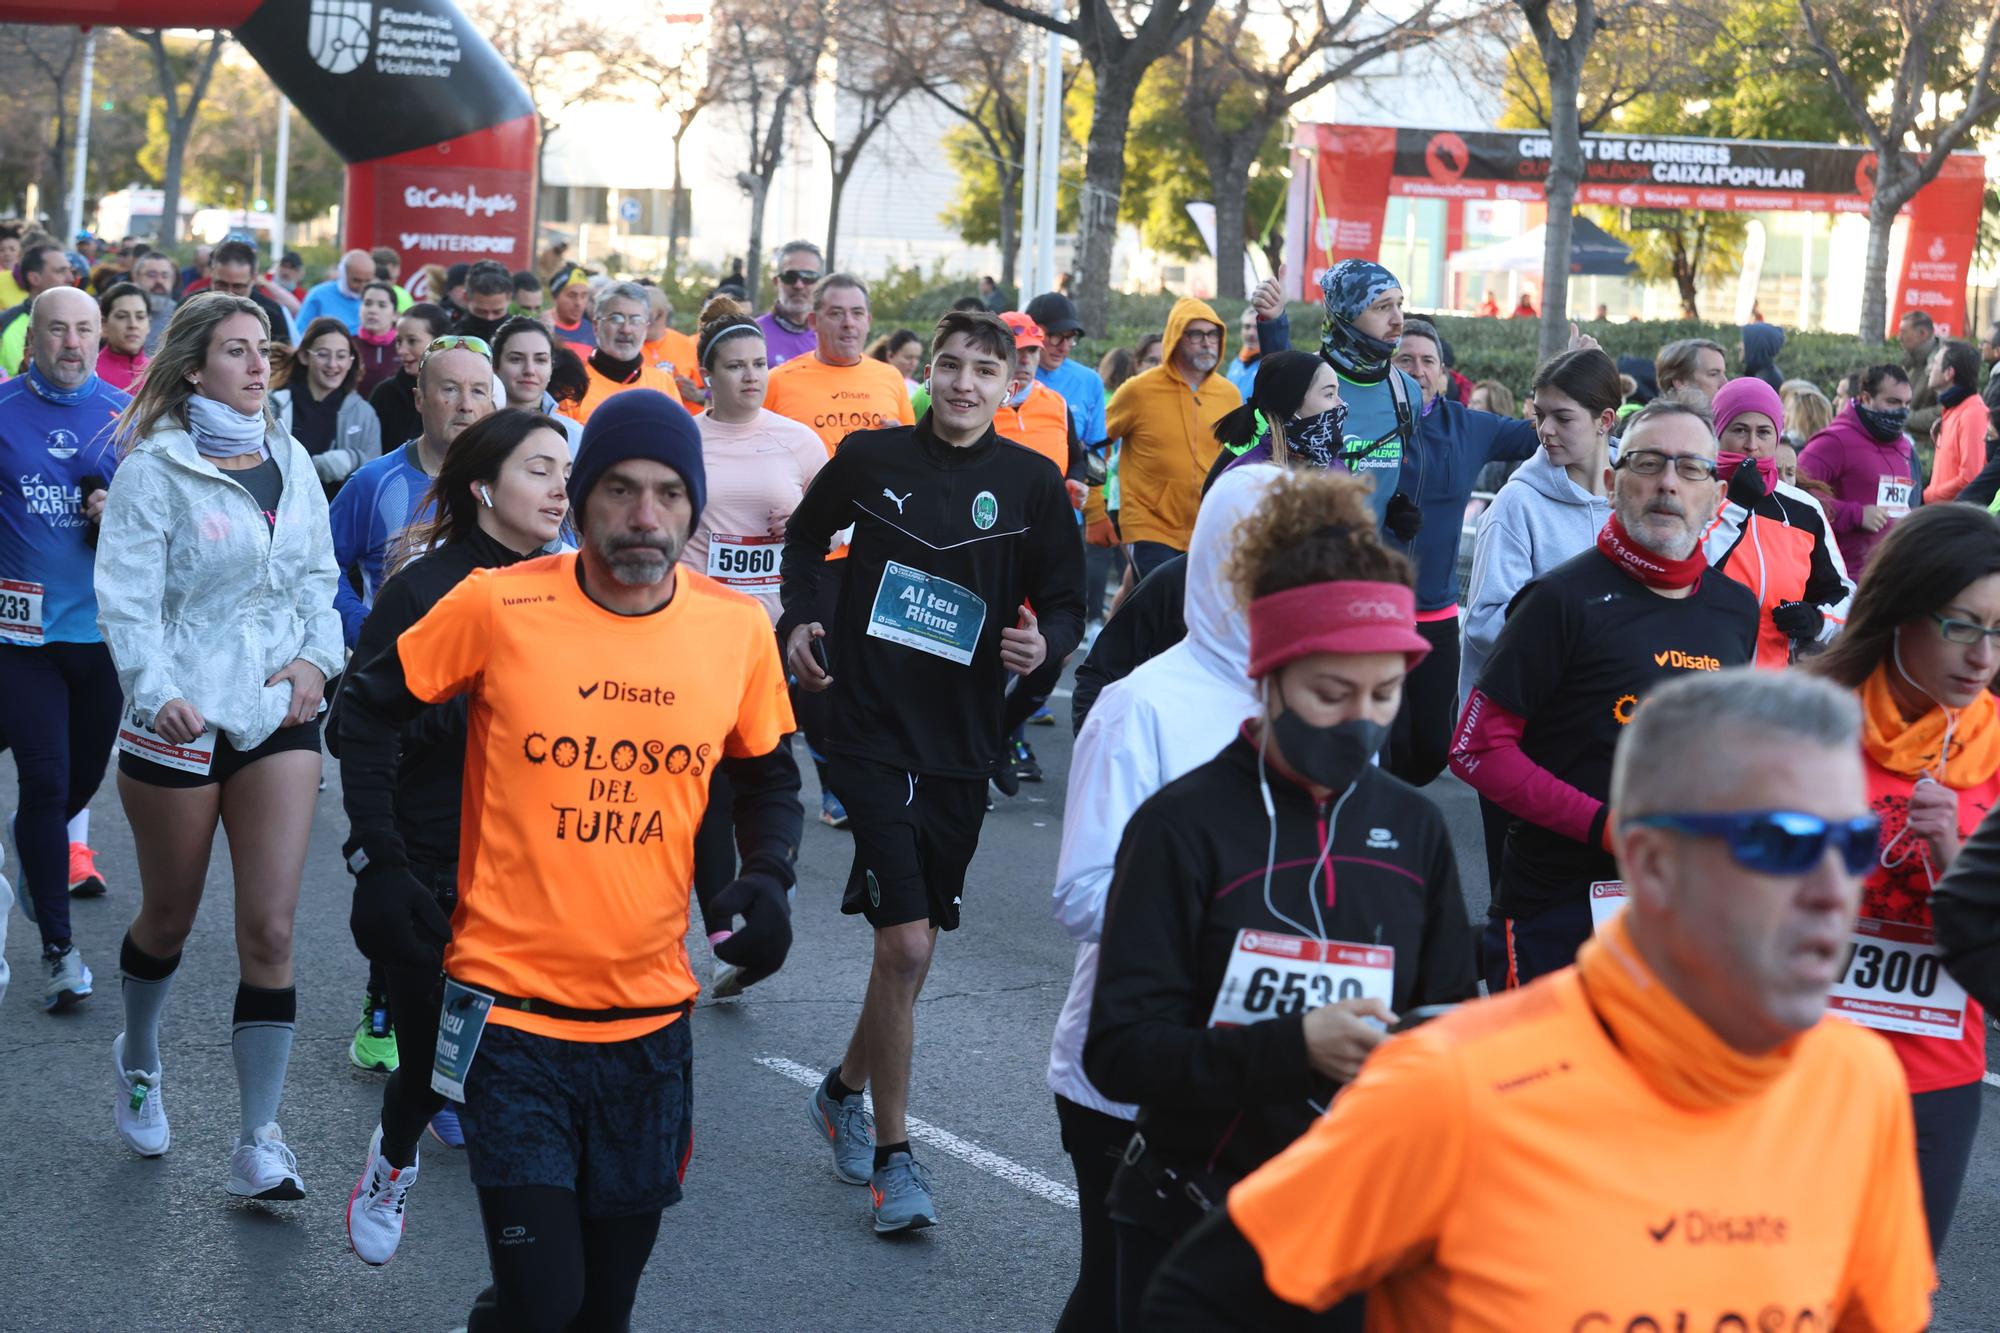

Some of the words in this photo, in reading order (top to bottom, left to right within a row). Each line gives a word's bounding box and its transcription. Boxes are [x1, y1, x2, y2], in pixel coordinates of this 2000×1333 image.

[376, 42, 461, 62] Municipal
[1599, 142, 1626, 161] DE
[1627, 142, 1731, 165] CARRERES
[420, 233, 516, 253] INTERSPORT
[814, 412, 888, 428] COLOSO
[49, 513, 89, 528] Valen
[719, 548, 774, 573] 5960
[899, 585, 925, 605] Al
[927, 593, 959, 616] teu
[905, 604, 958, 633] Ritme
[1670, 650, 1721, 672] Disate
[603, 680, 676, 706] Disate
[523, 730, 711, 777] COLOSOS
[589, 778, 638, 803] DEL
[551, 802, 664, 845] TURIA
[1685, 1210, 1789, 1245] Disate
